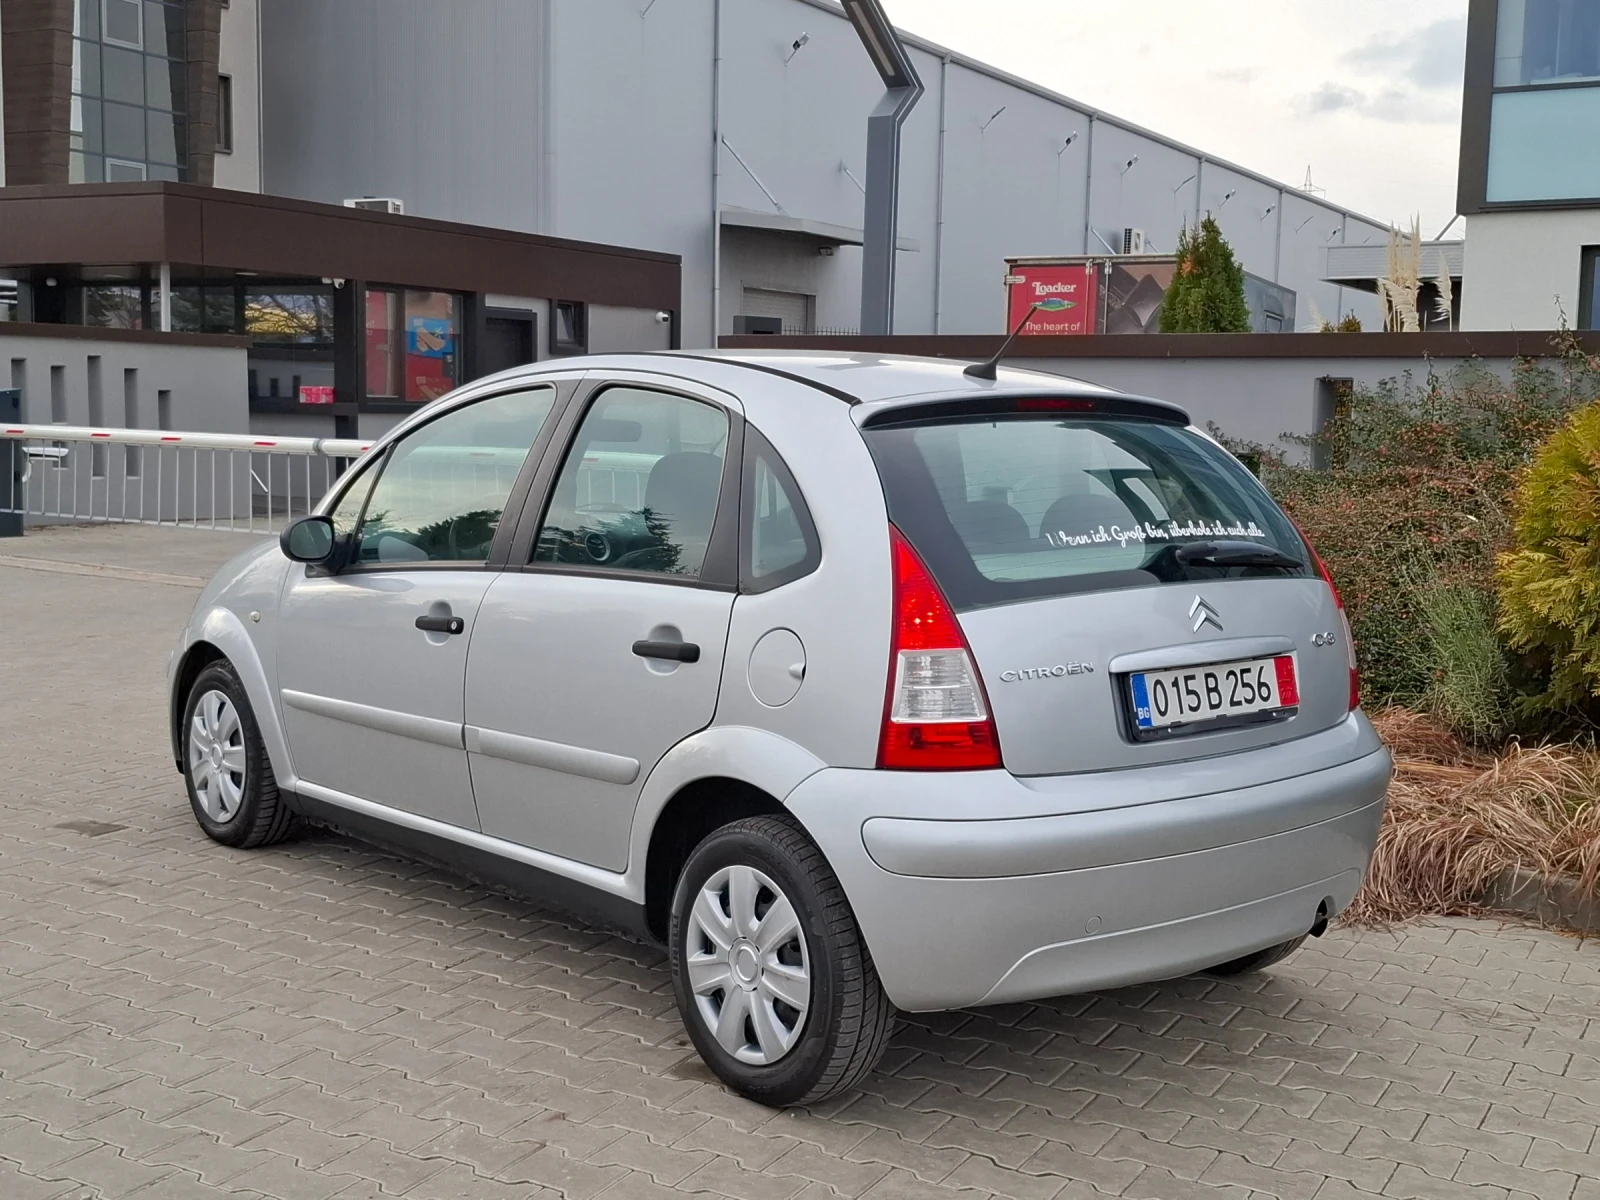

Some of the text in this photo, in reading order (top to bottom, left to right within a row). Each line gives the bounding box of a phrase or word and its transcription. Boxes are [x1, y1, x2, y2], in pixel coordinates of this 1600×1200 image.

[1031, 282, 1077, 295] Loacker
[1025, 321, 1081, 331] The heart of
[1090, 525, 1112, 543] ich
[1210, 519, 1228, 536] ich
[1311, 631, 1336, 648] C3
[999, 660, 1095, 683] CITROËN
[1137, 706, 1150, 720] BG
